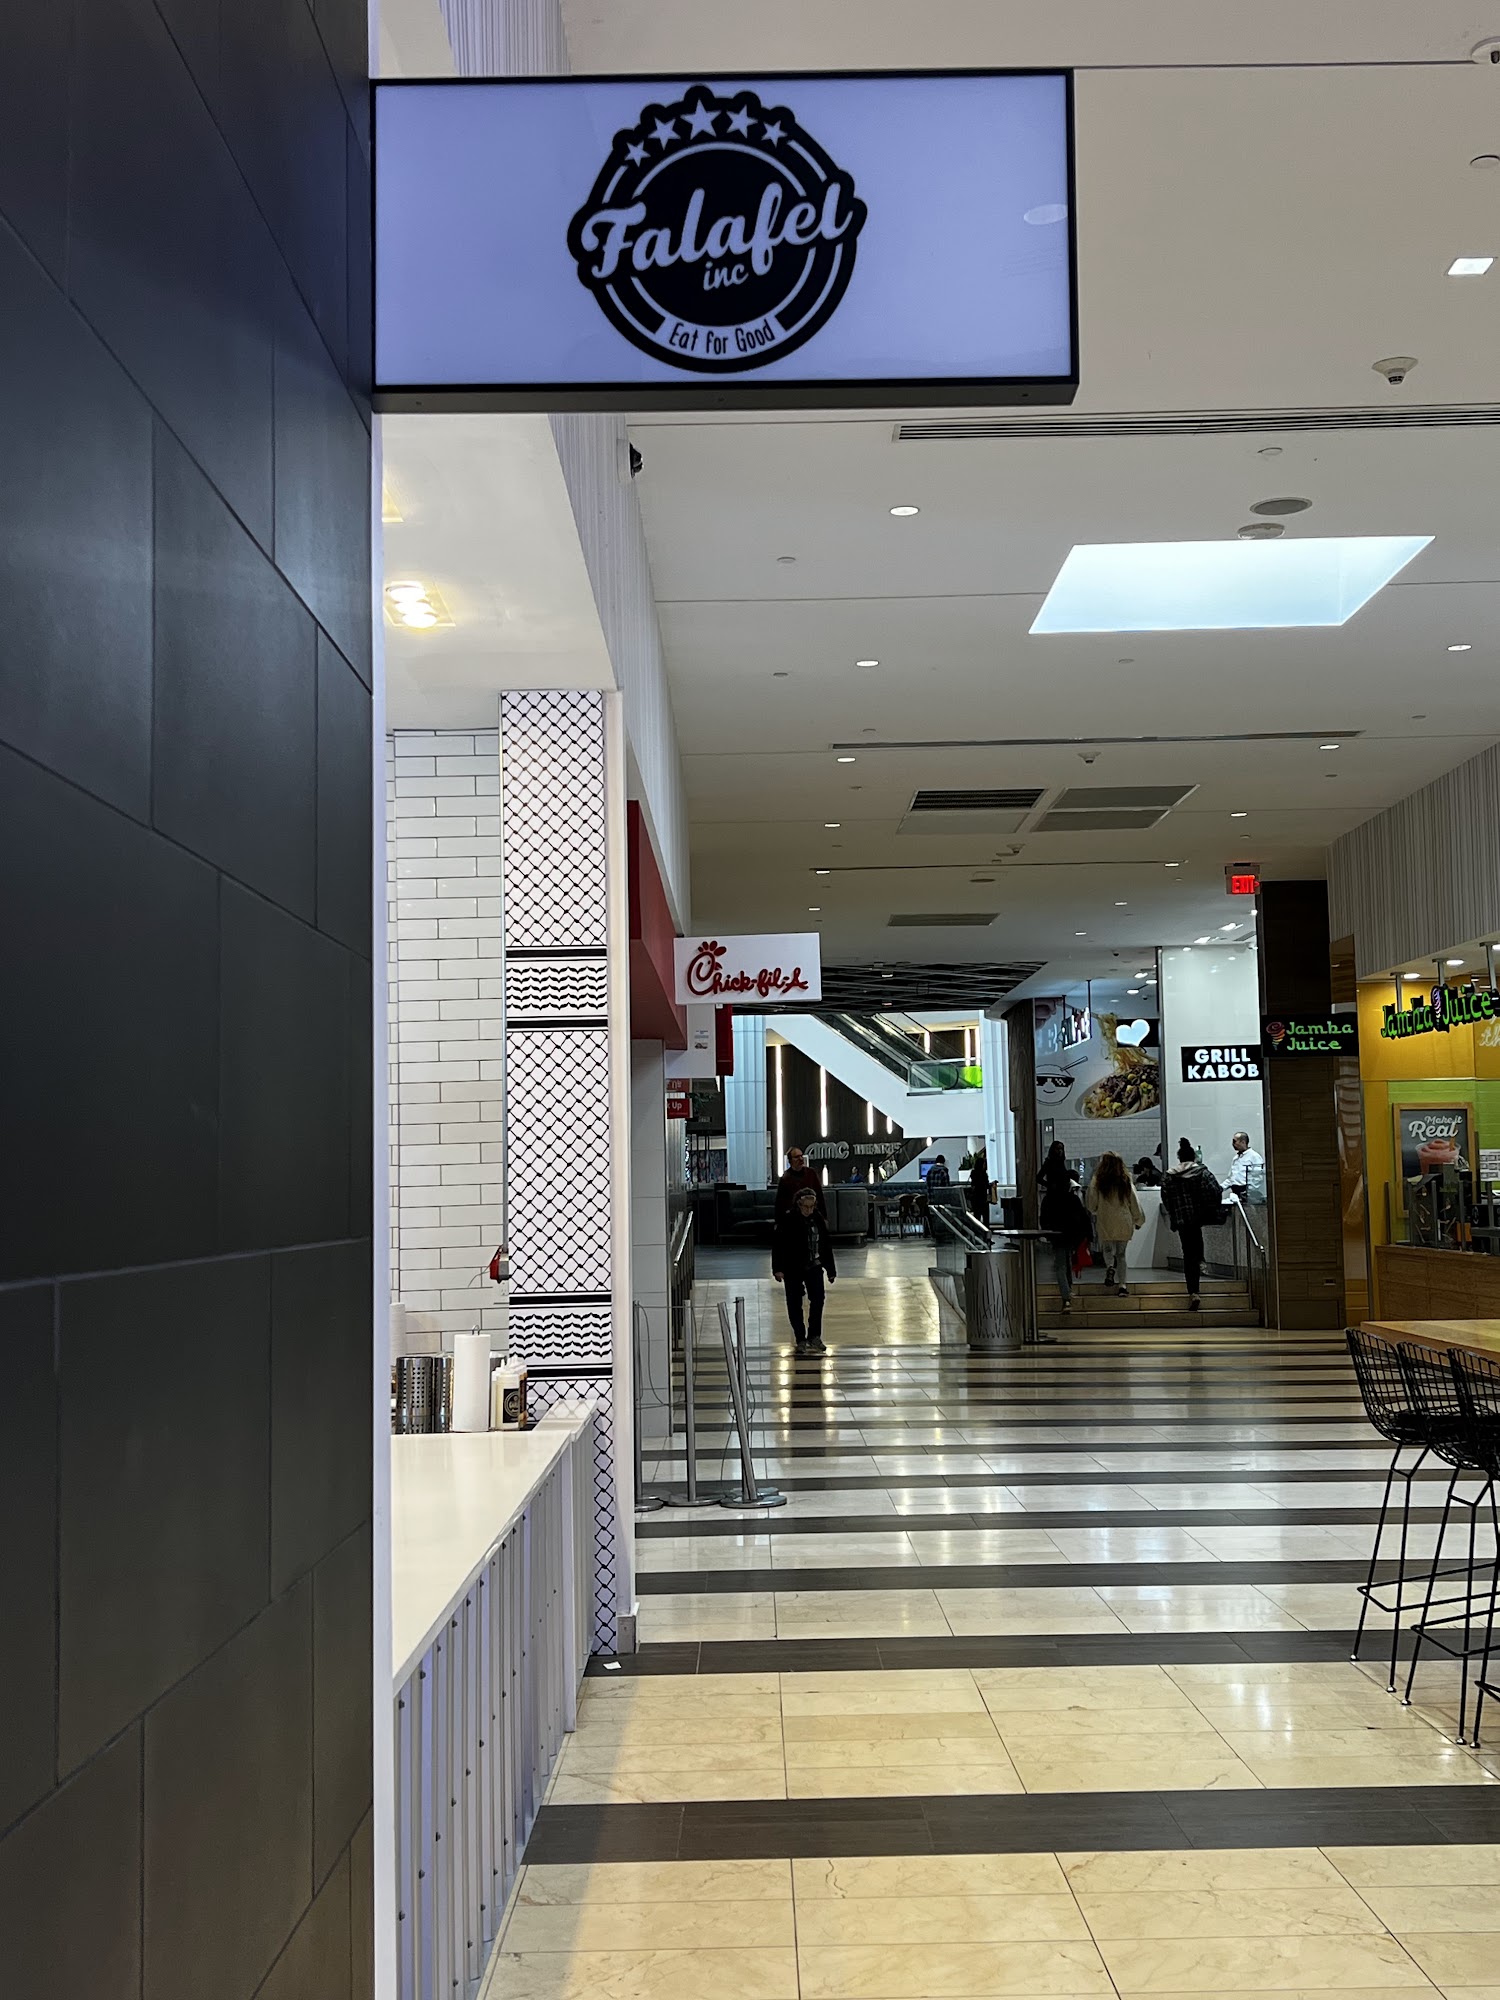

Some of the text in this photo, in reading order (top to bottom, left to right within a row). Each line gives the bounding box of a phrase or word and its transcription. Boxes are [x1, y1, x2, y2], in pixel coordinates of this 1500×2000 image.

[580, 181, 854, 279] Falafel
[702, 261, 749, 291] inc
[668, 318, 776, 355] Eat for Good
[1231, 874, 1255, 894] EXIT
[686, 944, 810, 998] Chick-fil-A
[1442, 984, 1495, 1025] Juice
[1285, 1020, 1355, 1035] Jamba
[1286, 1037, 1342, 1051] Juice
[1194, 1047, 1251, 1064] GRILL
[1187, 1063, 1260, 1080] KABOB
[1408, 1120, 1459, 1142] Real
